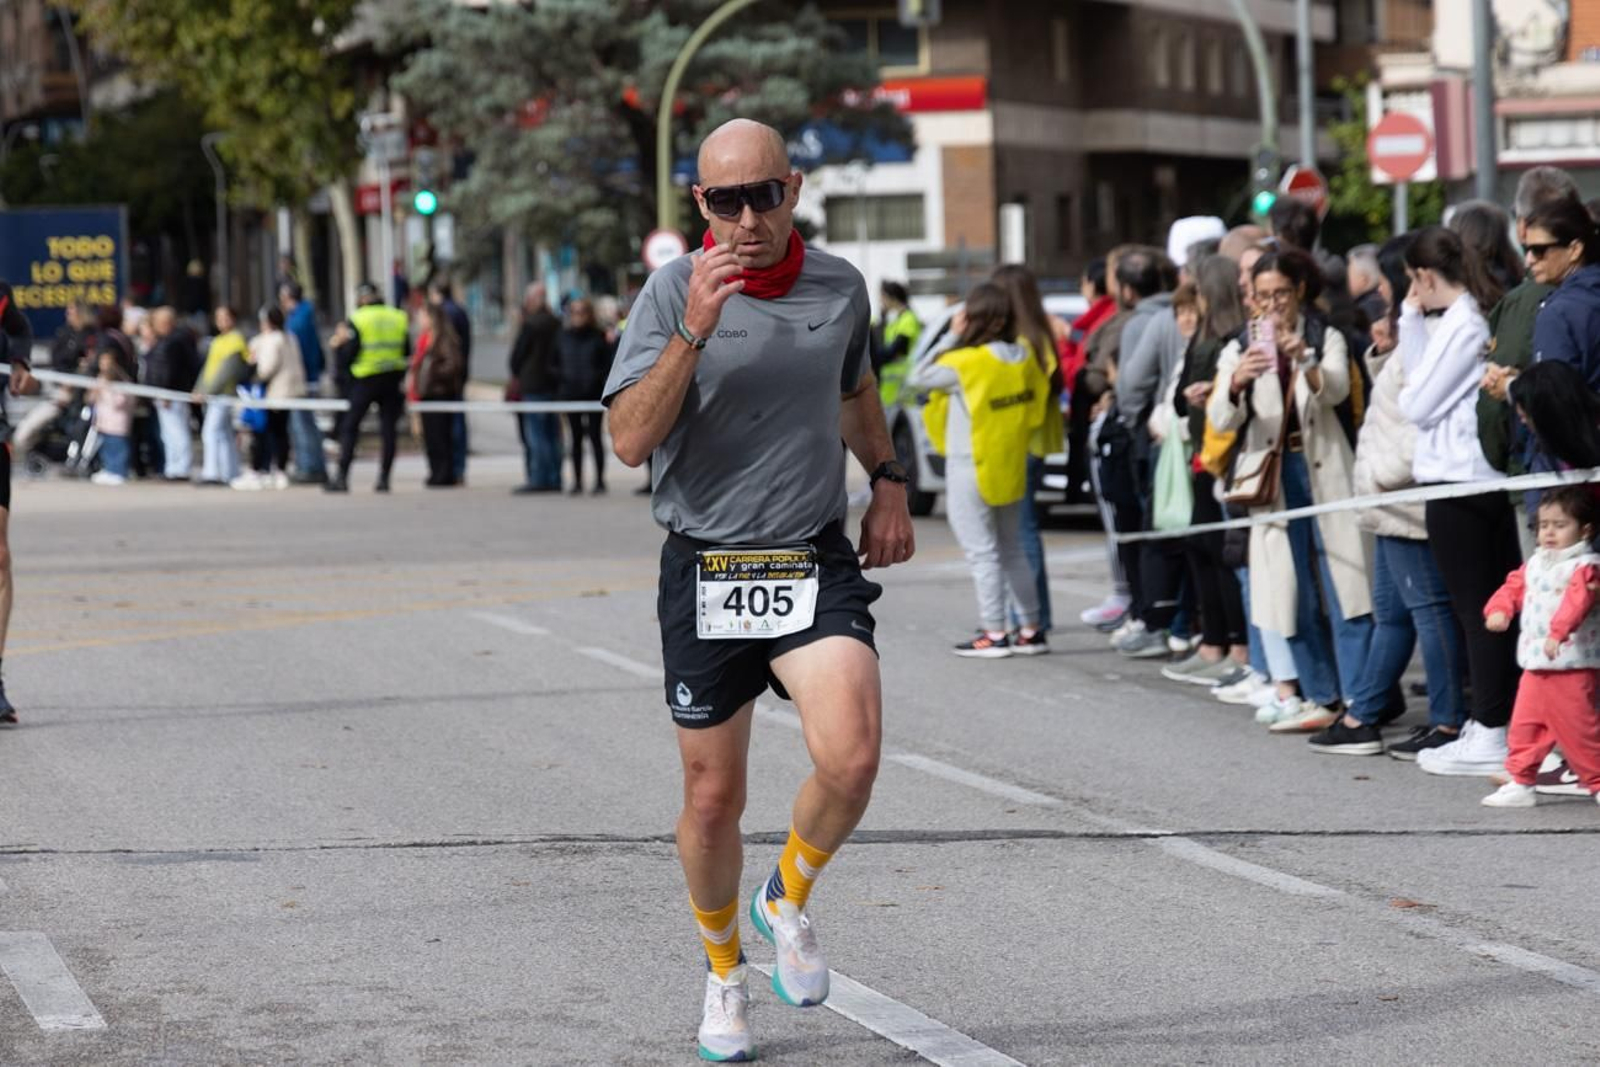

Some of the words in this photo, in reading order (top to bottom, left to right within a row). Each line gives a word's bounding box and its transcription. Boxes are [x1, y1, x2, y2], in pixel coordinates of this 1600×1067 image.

[46, 234, 115, 259] TODO
[31, 260, 63, 284] LO
[66, 259, 115, 282] QUE
[12, 283, 116, 308] ECESITAS
[717, 329, 748, 338] COBO
[730, 555, 771, 563] CARRERA
[772, 555, 809, 563] POPULA
[741, 563, 765, 571] gran
[769, 561, 813, 569] caminata
[723, 585, 794, 617] 405
